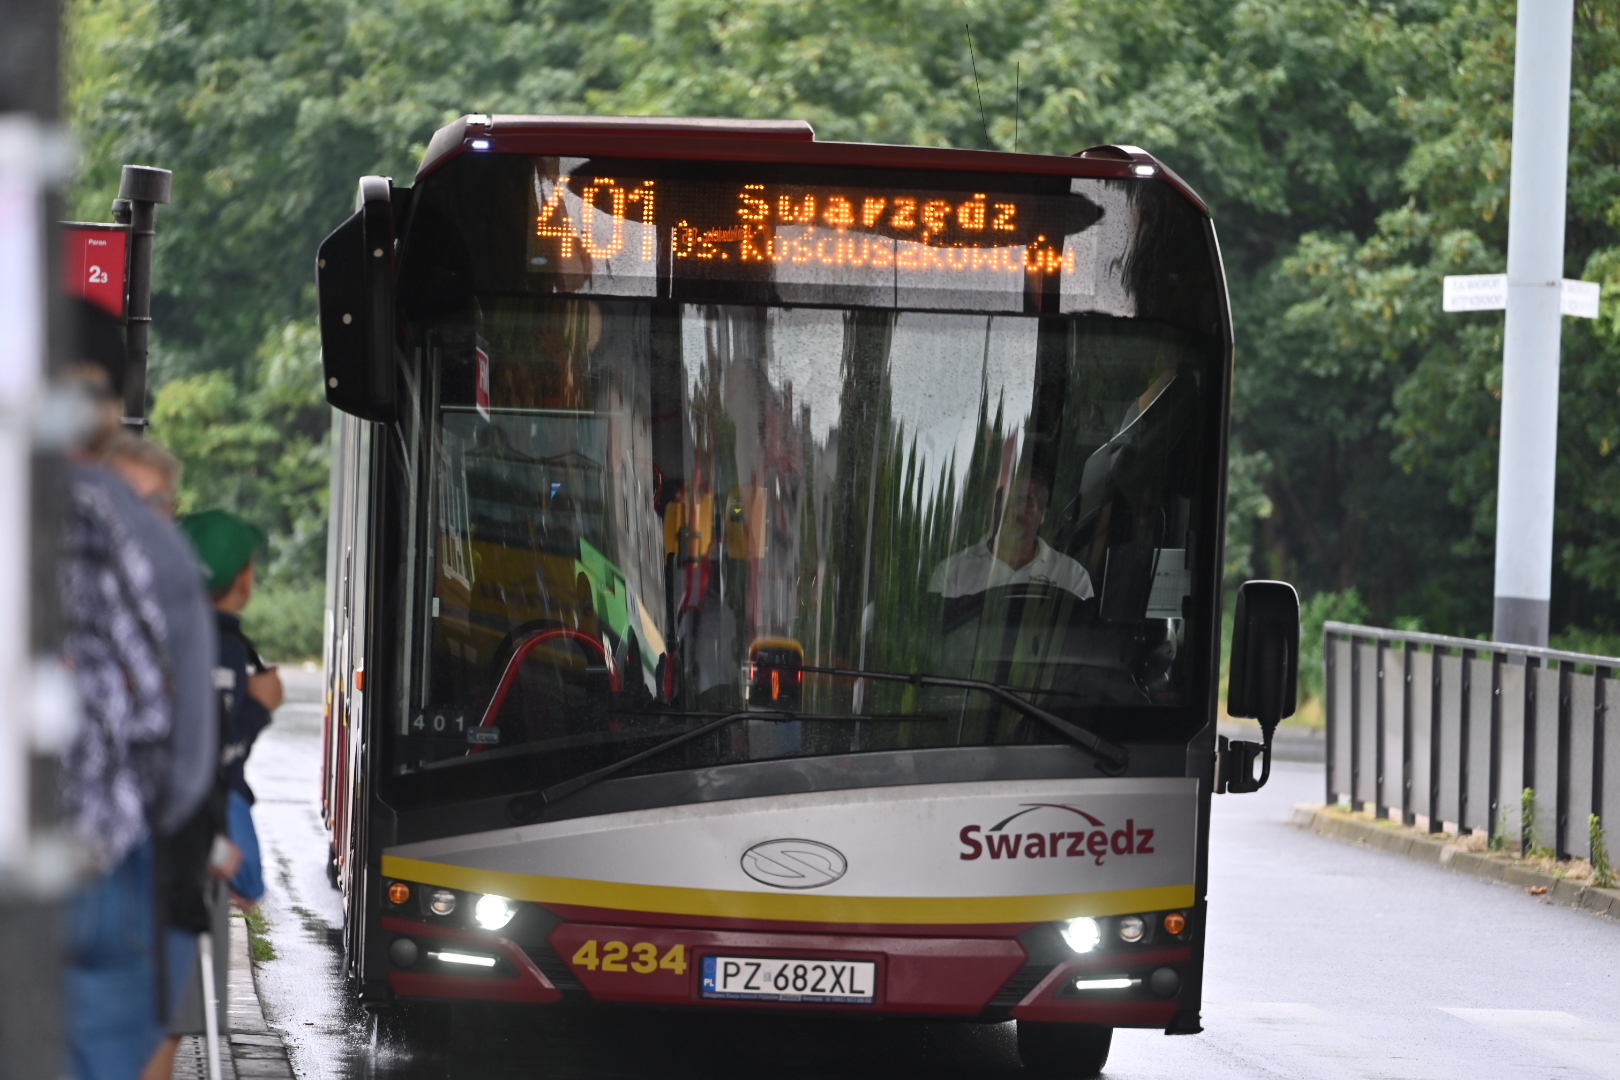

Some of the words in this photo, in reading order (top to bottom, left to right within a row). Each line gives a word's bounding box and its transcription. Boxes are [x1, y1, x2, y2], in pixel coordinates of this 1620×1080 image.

[537, 177, 655, 260] 401
[738, 183, 1017, 233] Swarzędz
[88, 265, 108, 283] 23
[413, 714, 464, 732] 401
[959, 818, 1154, 867] Swarzędz
[572, 940, 687, 975] 4234
[703, 978, 715, 987] PL
[723, 961, 762, 990] PZ
[773, 963, 865, 994] 682XL
